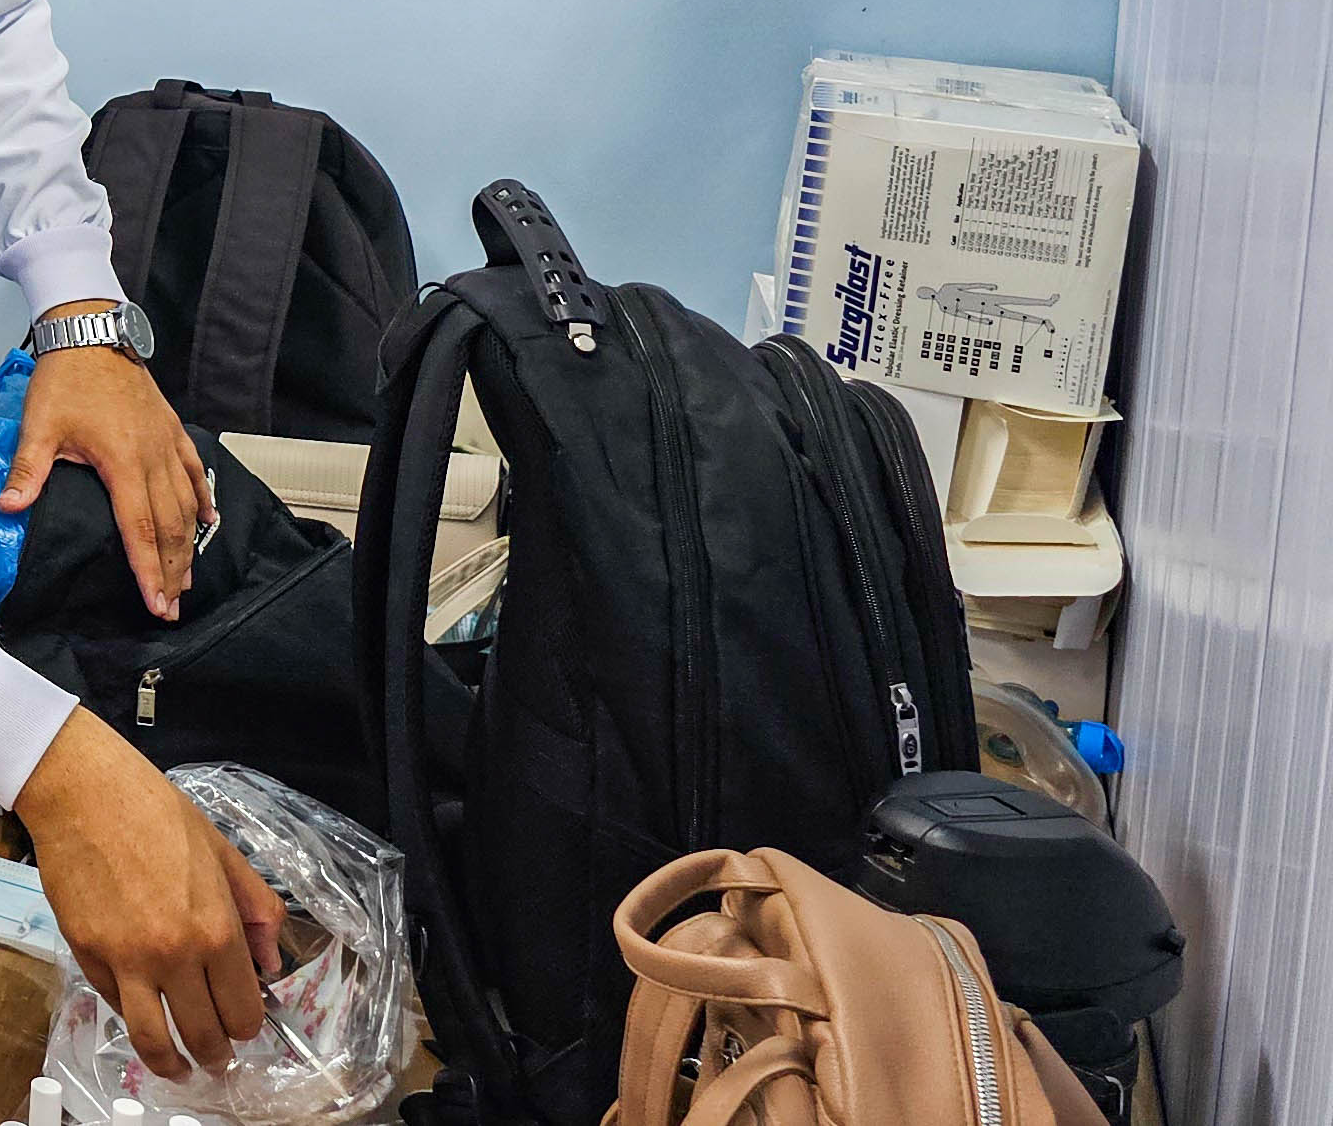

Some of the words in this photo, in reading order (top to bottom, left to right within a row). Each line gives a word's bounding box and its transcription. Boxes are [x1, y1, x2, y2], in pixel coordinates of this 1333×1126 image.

[897, 260, 909, 291] Retainer
[826, 244, 874, 370] Surgilast
[870, 258, 895, 364] Latex-Free
[893, 293, 906, 324] Dressing
[889, 326, 900, 349] Elastic
[884, 350, 896, 377] Tubular
